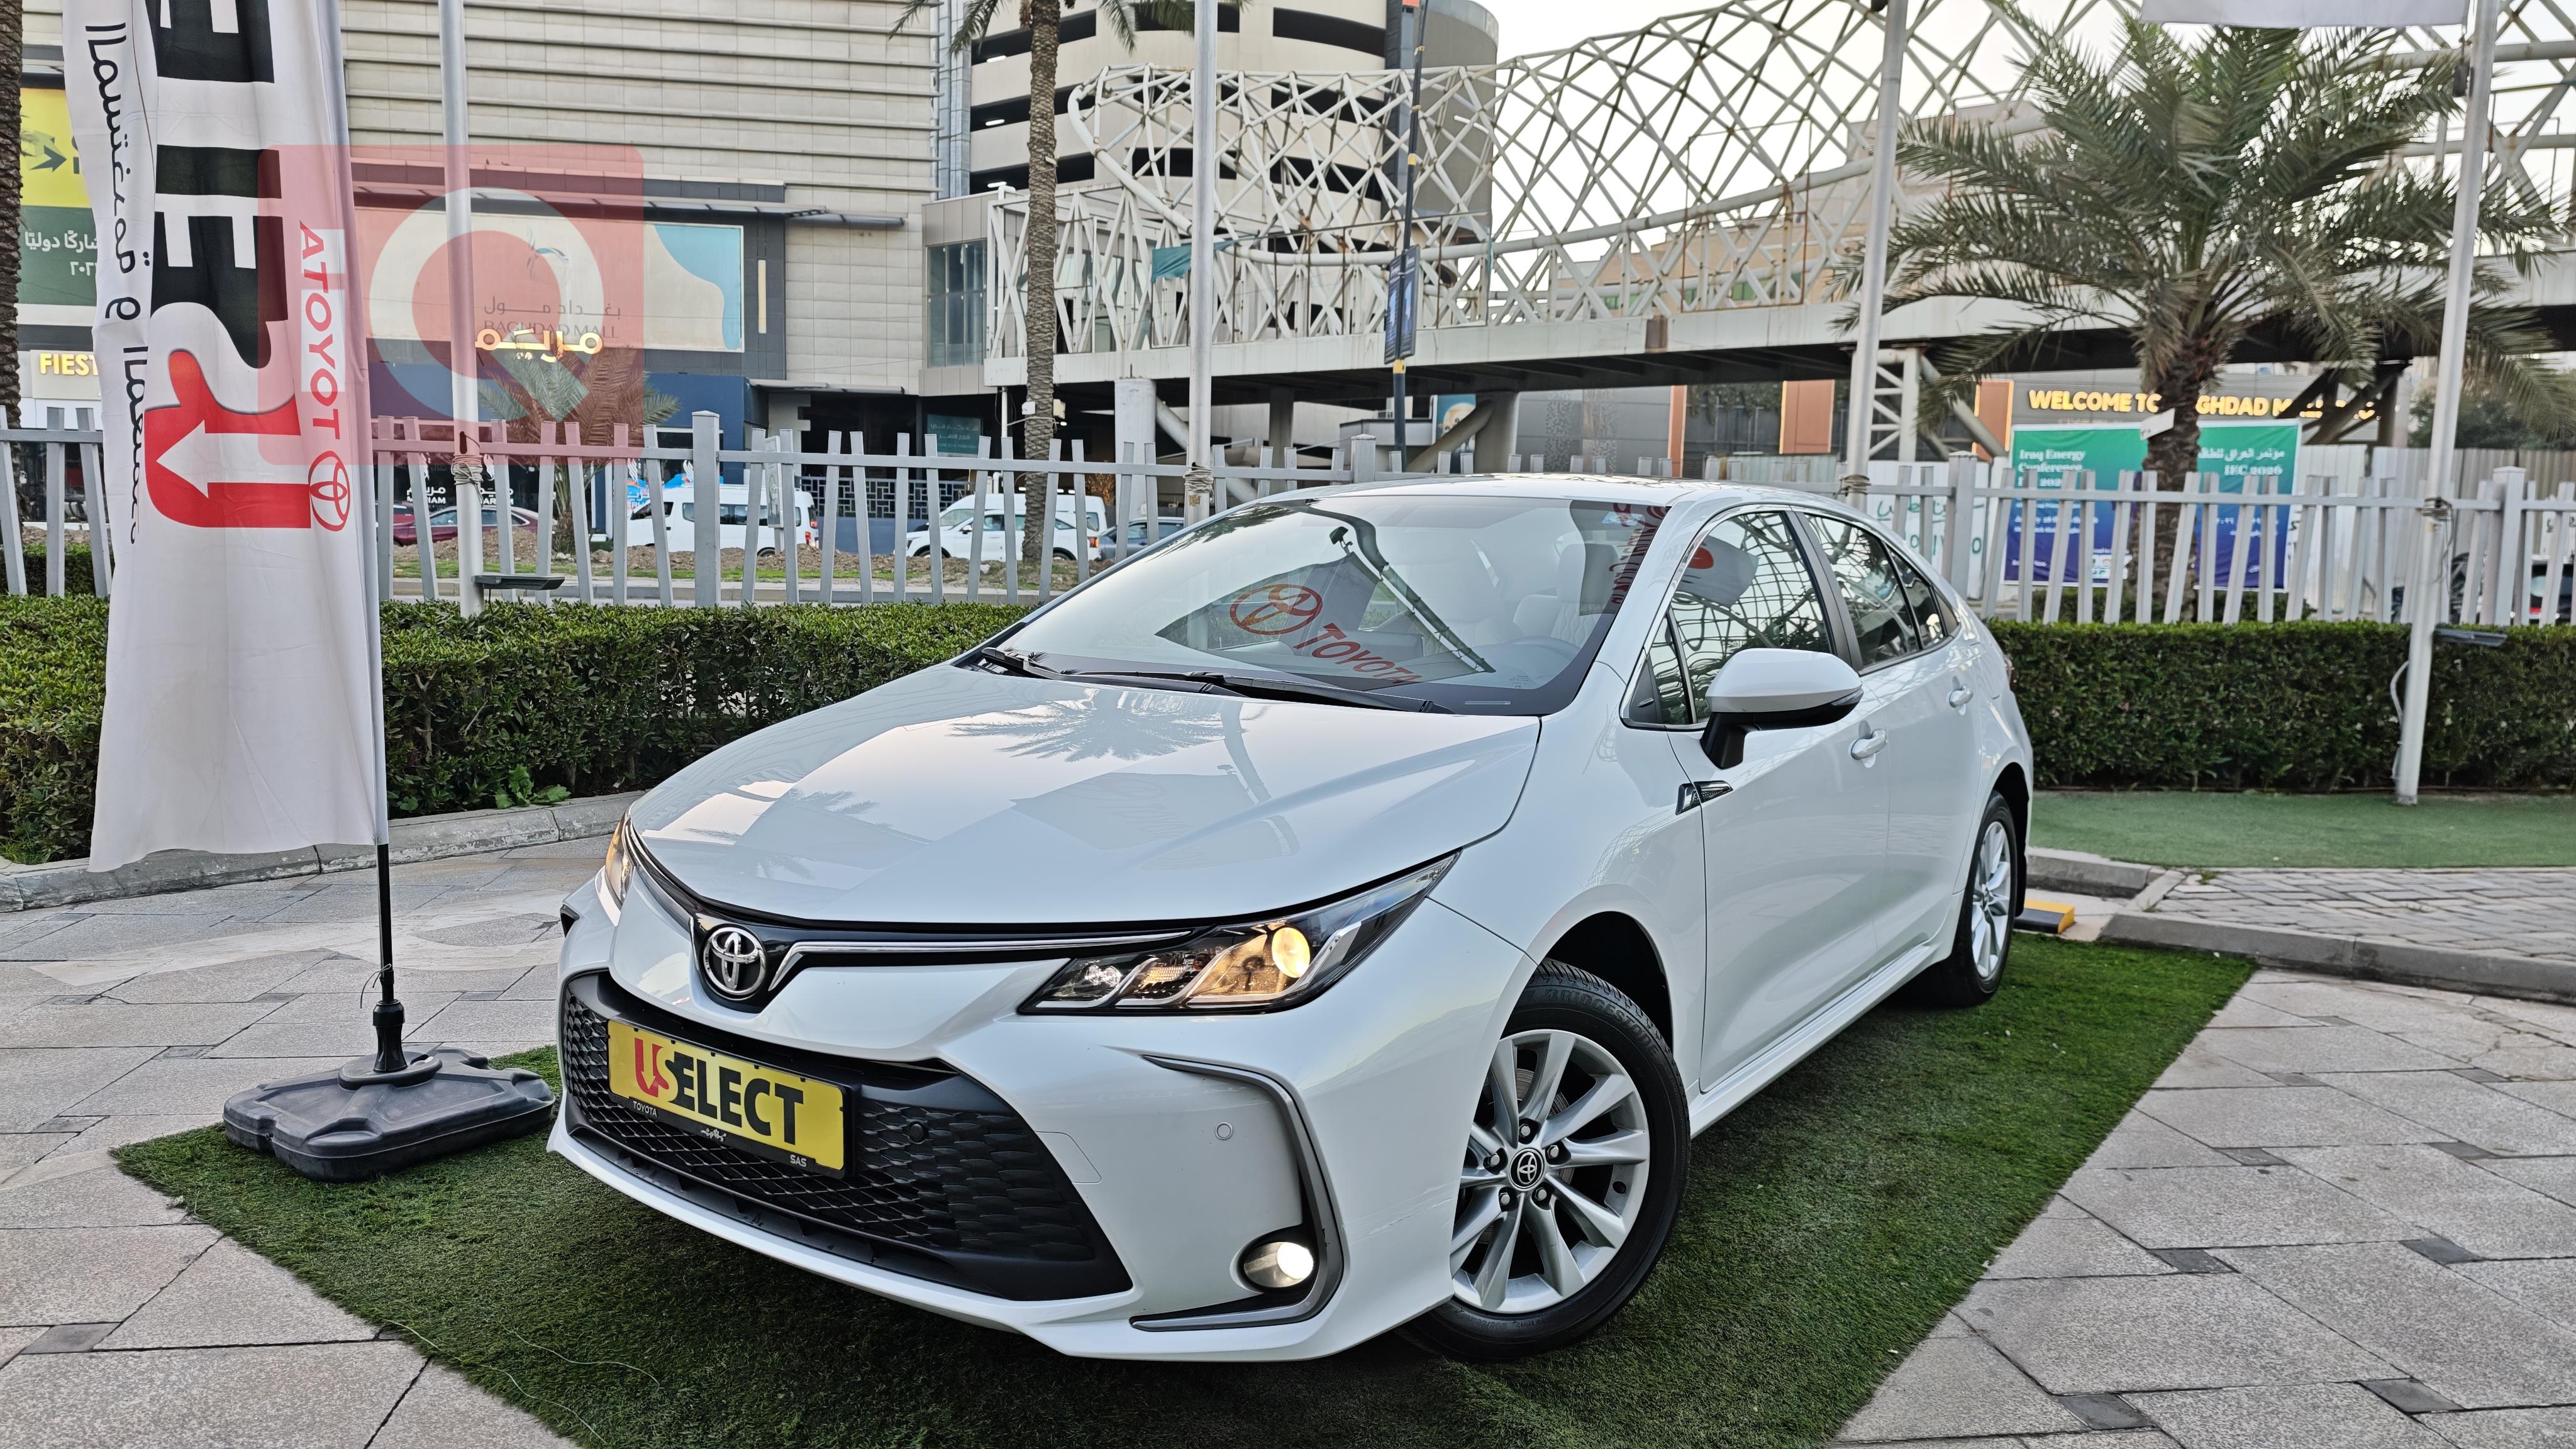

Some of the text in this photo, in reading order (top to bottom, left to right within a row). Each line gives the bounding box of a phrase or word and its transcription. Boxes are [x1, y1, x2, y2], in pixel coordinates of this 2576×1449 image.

[70, 261, 97, 276] ٢٠٢
[484, 296, 621, 319] بغداد مول
[484, 319, 620, 339] BAGHDAD MALL
[2028, 389, 2133, 413] WELCOME
[2195, 394, 2269, 416] GHDAD
[2019, 448, 2087, 462] Iraq Energy
[2040, 477, 2063, 487] 202
[406, 496, 447, 504] MIAM
[1293, 623, 1423, 684] TOYOTA
[632, 1101, 658, 1118] TOYOTA
[789, 1154, 808, 1167] SAS
